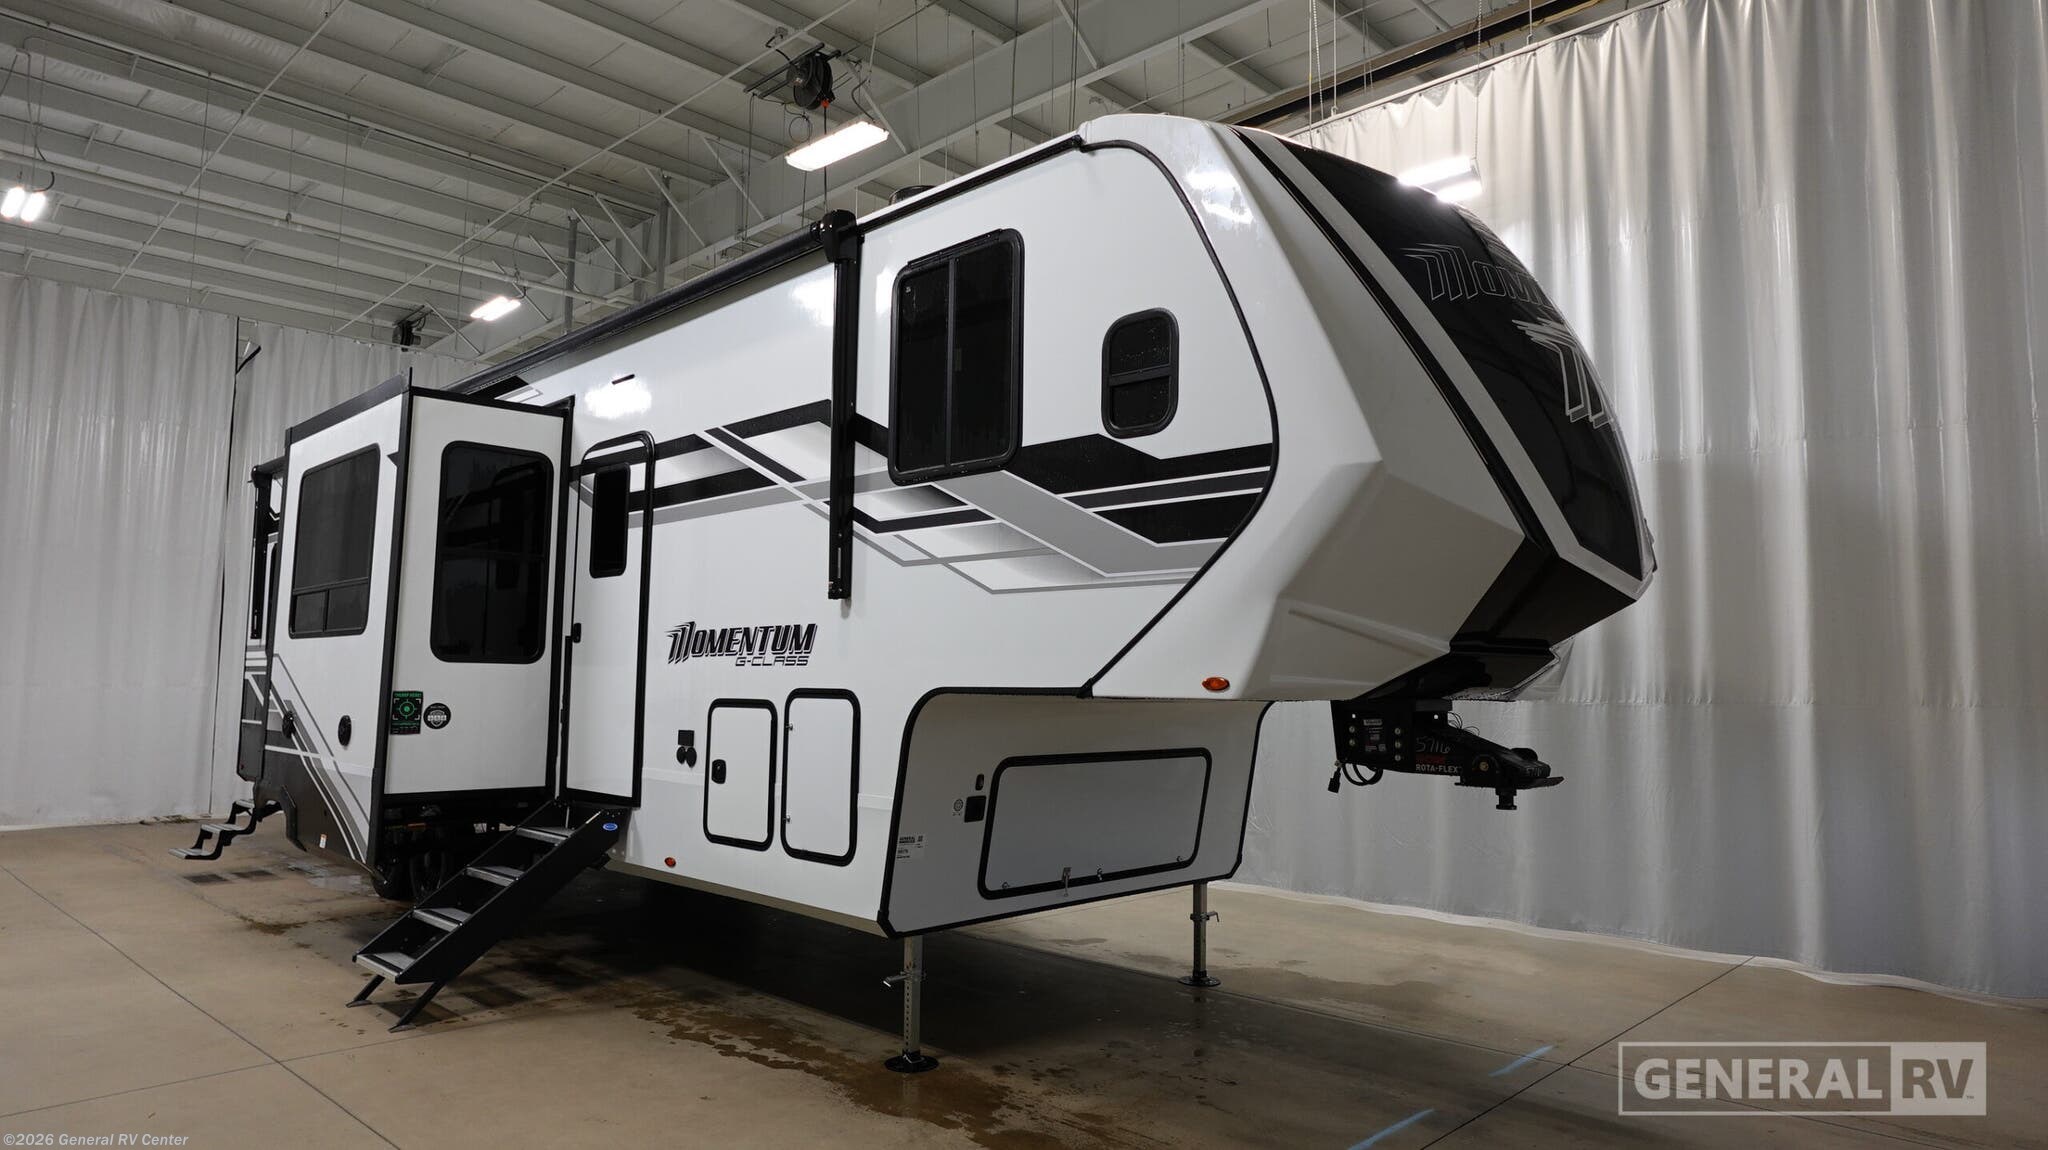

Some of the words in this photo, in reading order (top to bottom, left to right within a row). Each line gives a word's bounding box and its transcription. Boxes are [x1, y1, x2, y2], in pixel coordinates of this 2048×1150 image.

[665, 621, 818, 664] MOMENTUM
[735, 656, 809, 666] G-CLASS
[1415, 764, 1458, 774] ROTA-FLEX
